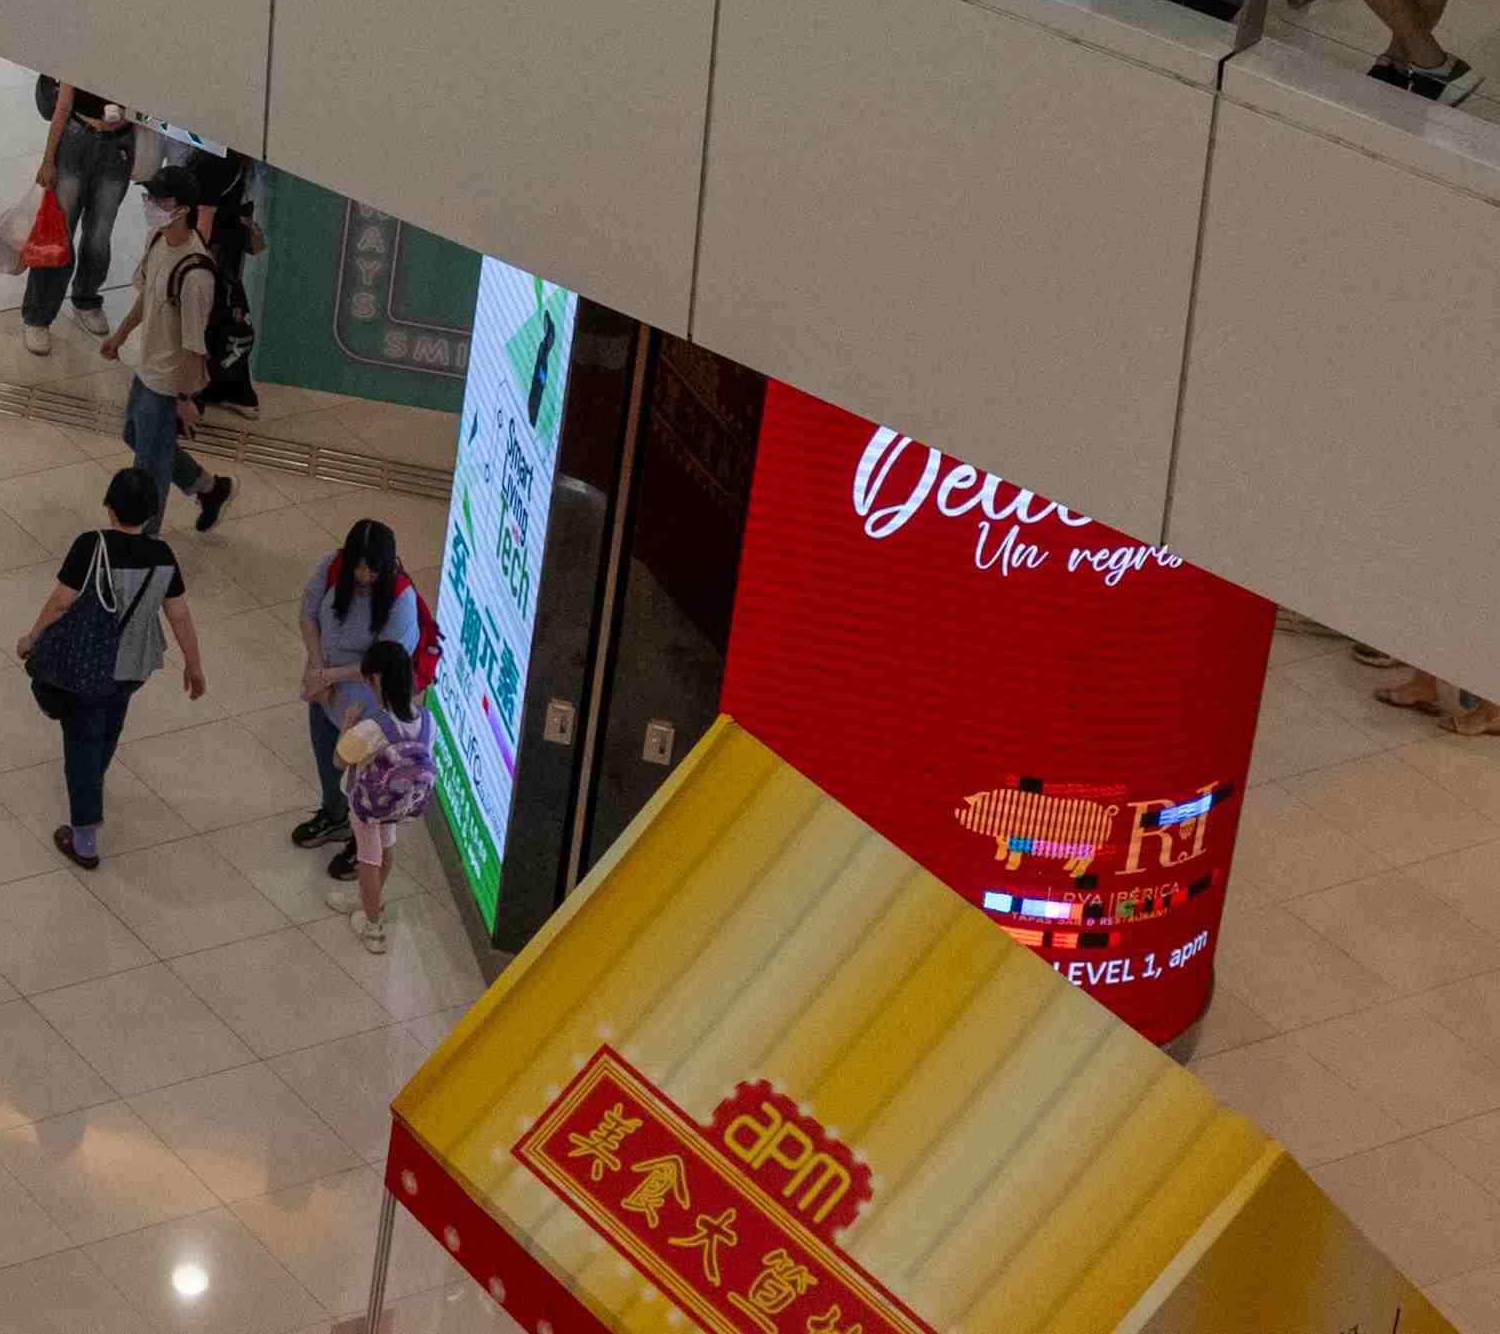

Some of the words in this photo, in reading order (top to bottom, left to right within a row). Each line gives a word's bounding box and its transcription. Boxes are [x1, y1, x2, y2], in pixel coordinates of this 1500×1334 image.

[501, 452, 529, 548] Living
[507, 417, 534, 502] Smart
[495, 494, 531, 622] Tech
[974, 520, 1049, 578] Un
[1051, 956, 1136, 987] EVEL
[1168, 929, 1209, 970] apm
[723, 1101, 852, 1225] apm
